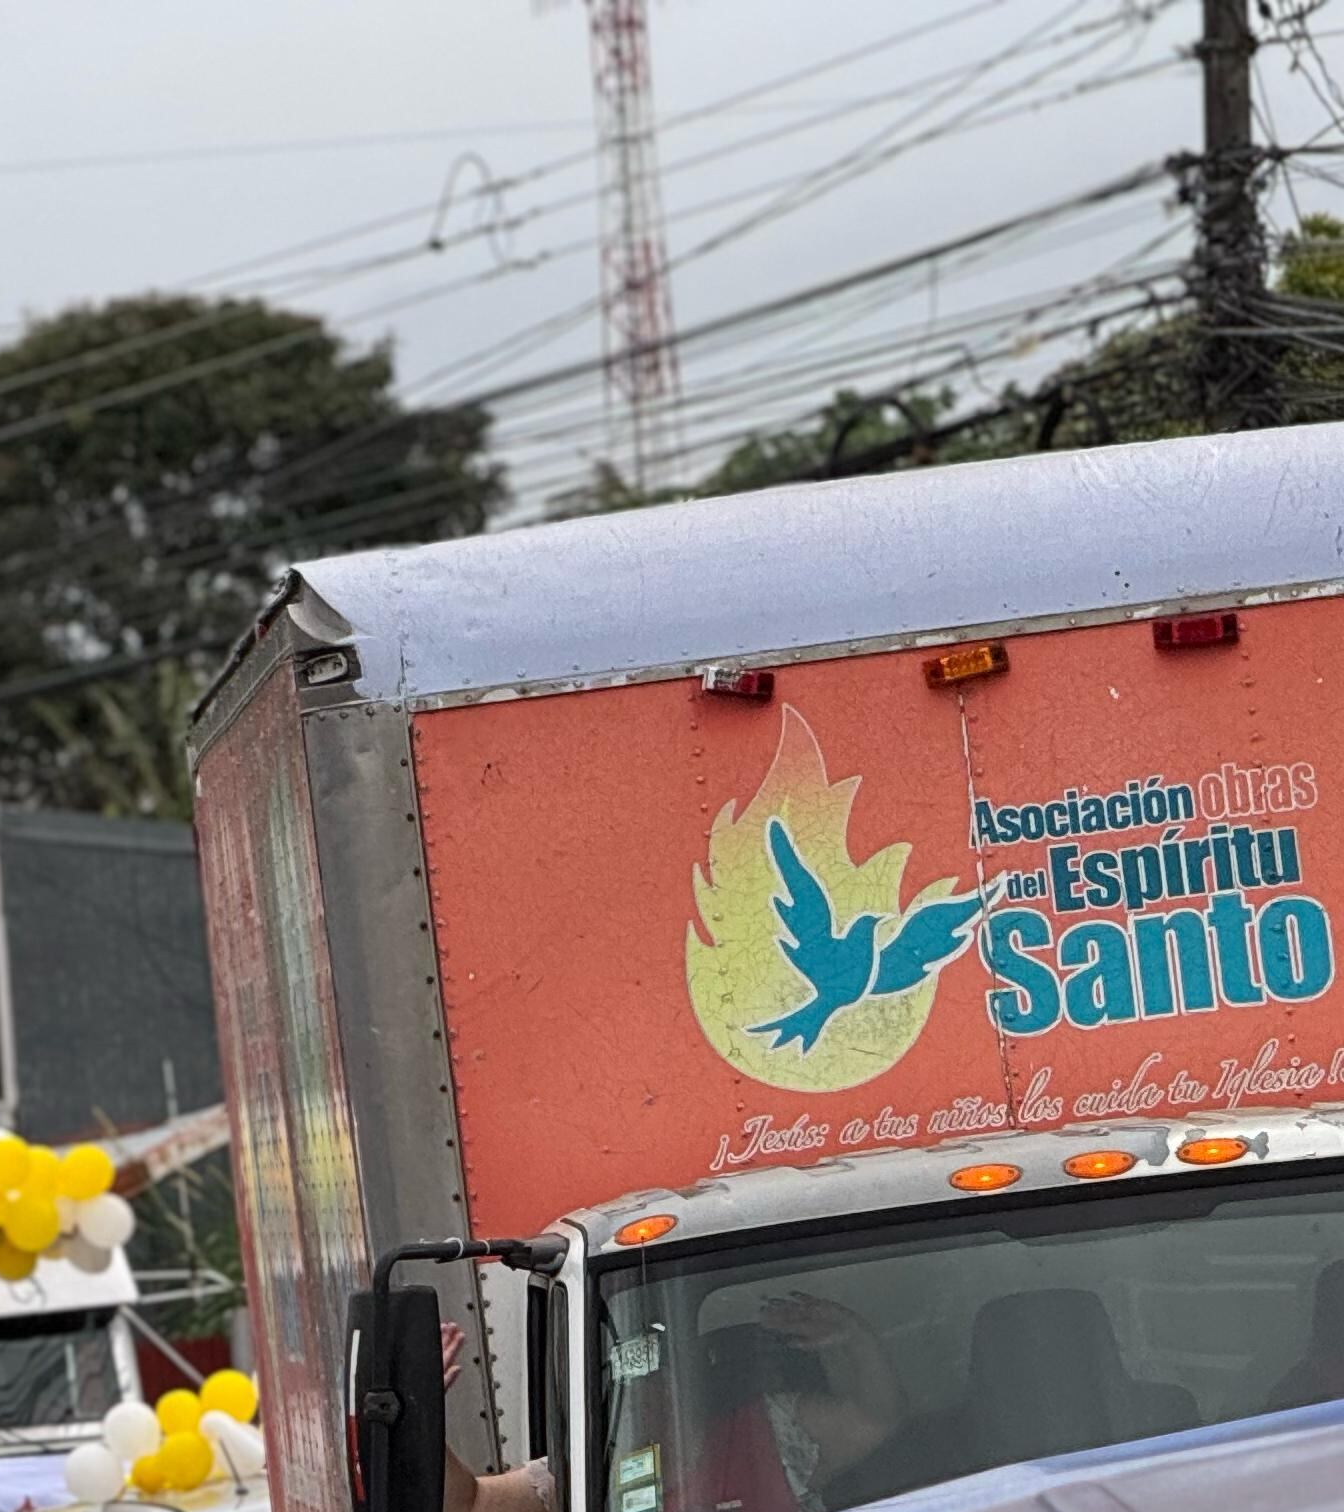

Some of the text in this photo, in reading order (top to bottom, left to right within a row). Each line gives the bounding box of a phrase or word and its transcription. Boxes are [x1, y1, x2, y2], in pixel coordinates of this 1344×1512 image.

[970, 762, 1318, 848] Asociación obras
[1006, 823, 1302, 914] del Espíritu
[978, 888, 1335, 1037] Santo
[839, 1118, 869, 1144] a
[873, 1105, 919, 1139] tus
[927, 1096, 1009, 1134] niños
[1018, 1066, 1062, 1122] los
[1073, 1052, 1164, 1116] cuida
[1168, 1070, 1208, 1103] tu
